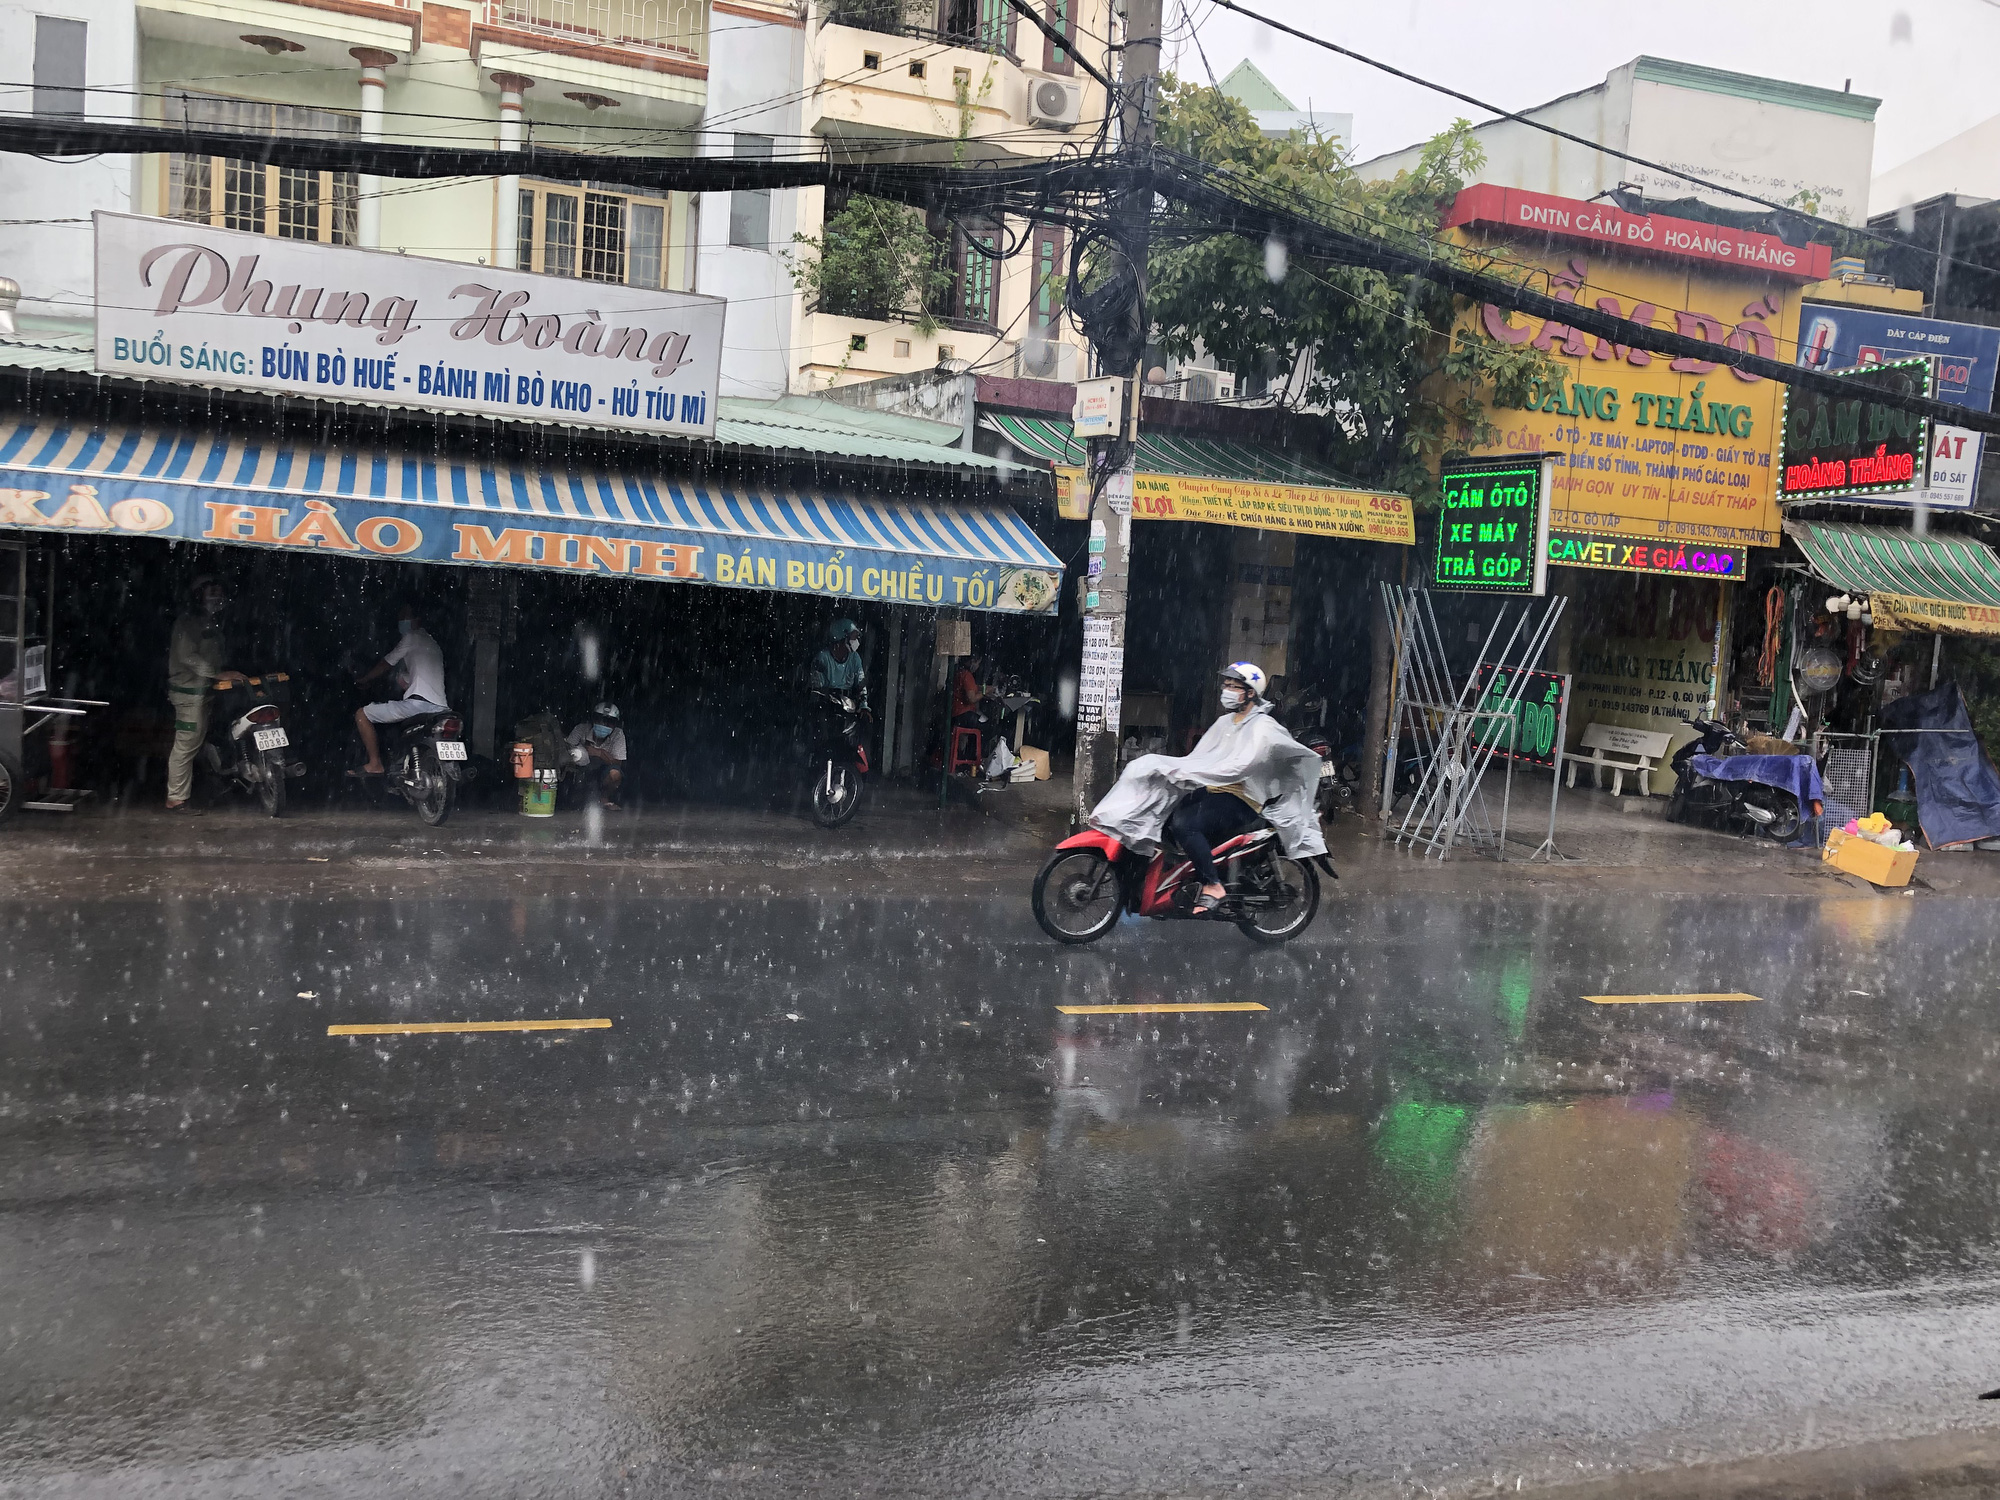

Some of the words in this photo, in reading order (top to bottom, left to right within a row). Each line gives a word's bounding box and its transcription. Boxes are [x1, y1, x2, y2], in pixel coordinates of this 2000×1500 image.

[1520, 203, 1570, 228] DNTN
[1575, 210, 1622, 238] CẦM
[1626, 217, 1655, 242] ĐỒ
[1664, 229, 1732, 256] HOÀNG
[1737, 237, 1796, 267] THẮNG
[139, 243, 421, 346] Phụng
[448, 283, 694, 379] Hoàng
[114, 330, 172, 366] BUỔI
[180, 342, 254, 376] SÁNG:
[262, 342, 309, 382] BÚN
[317, 347, 346, 386] BÒ
[354, 351, 398, 391] HUẾ
[418, 360, 477, 400] BÁNH
[484, 367, 510, 403] MÌ
[517, 371, 544, 407] BÒ
[550, 379, 592, 413] KHO
[612, 379, 639, 418] HỦ
[645, 385, 675, 422] TÍU
[681, 390, 706, 425] MÌ
[1633, 381, 1753, 438] THẮNG
[1555, 423, 1564, 441] Ô
[1567, 427, 1581, 443] TÔ
[1589, 431, 1603, 446] XE
[1606, 430, 1629, 450] MÁY
[1636, 439, 1675, 455] LAPTOP
[1716, 446, 1740, 464] GIẤY
[1757, 453, 1770, 467] XE
[1569, 449, 1595, 470] BIỂN
[1597, 453, 1612, 471] SỐ
[1646, 460, 1679, 480] THÀNH
[1682, 465, 1703, 483] PHỐ
[1705, 468, 1726, 485] CÁC
[1728, 472, 1750, 490] LOẠI
[1786, 456, 1846, 490] HOÀNG
[1850, 443, 1914, 484] THẮNG
[1144, 495, 1175, 518] LỢI
[1202, 494, 1222, 506] THIẾT
[1369, 498, 1402, 513] 466
[1586, 479, 1614, 498] GỌN
[1622, 483, 1639, 498] UY
[1642, 485, 1661, 501] TÍN
[1669, 488, 1690, 504] LÃI
[1691, 489, 1724, 507] SUẤT
[1241, 512, 1262, 523] CHỨA
[1264, 513, 1287, 526] HÀNG
[1289, 518, 1295, 526] &
[1297, 518, 1313, 529] KHO
[1315, 519, 1337, 530] PHÂN
[1450, 523, 1473, 543] XE
[1479, 517, 1518, 543] MÁY
[1571, 512, 1581, 526] Q.
[1584, 511, 1598, 526] GÒ
[1602, 512, 1621, 528] VẤP
[0, 484, 174, 532] XÀO
[202, 499, 424, 555] HÀO
[451, 523, 705, 580] MINH
[716, 550, 777, 585] BÁN
[787, 550, 855, 594] BUỔI
[861, 558, 944, 603] CHIỀU
[952, 565, 995, 608] TỐI
[1548, 539, 1616, 564] CAVET
[1621, 545, 1648, 567] XE
[1652, 545, 1688, 570] GIÁ
[1691, 553, 1734, 575] CAO
[1443, 549, 1476, 577] TRẢ
[1482, 552, 1522, 577] GÓP
[1967, 605, 2000, 626] VẠN
[1098, 638, 1108, 648] 074
[1095, 667, 1105, 676] 074
[1645, 648, 1713, 685] THẮNG
[1602, 700, 1619, 711] 0919
[1621, 702, 1649, 714] 143769
[1648, 689, 1665, 700] P.12
[1673, 691, 1681, 703] Q.
[1682, 690, 1694, 703] GÒ
[1085, 713, 1101, 722] GÓP
